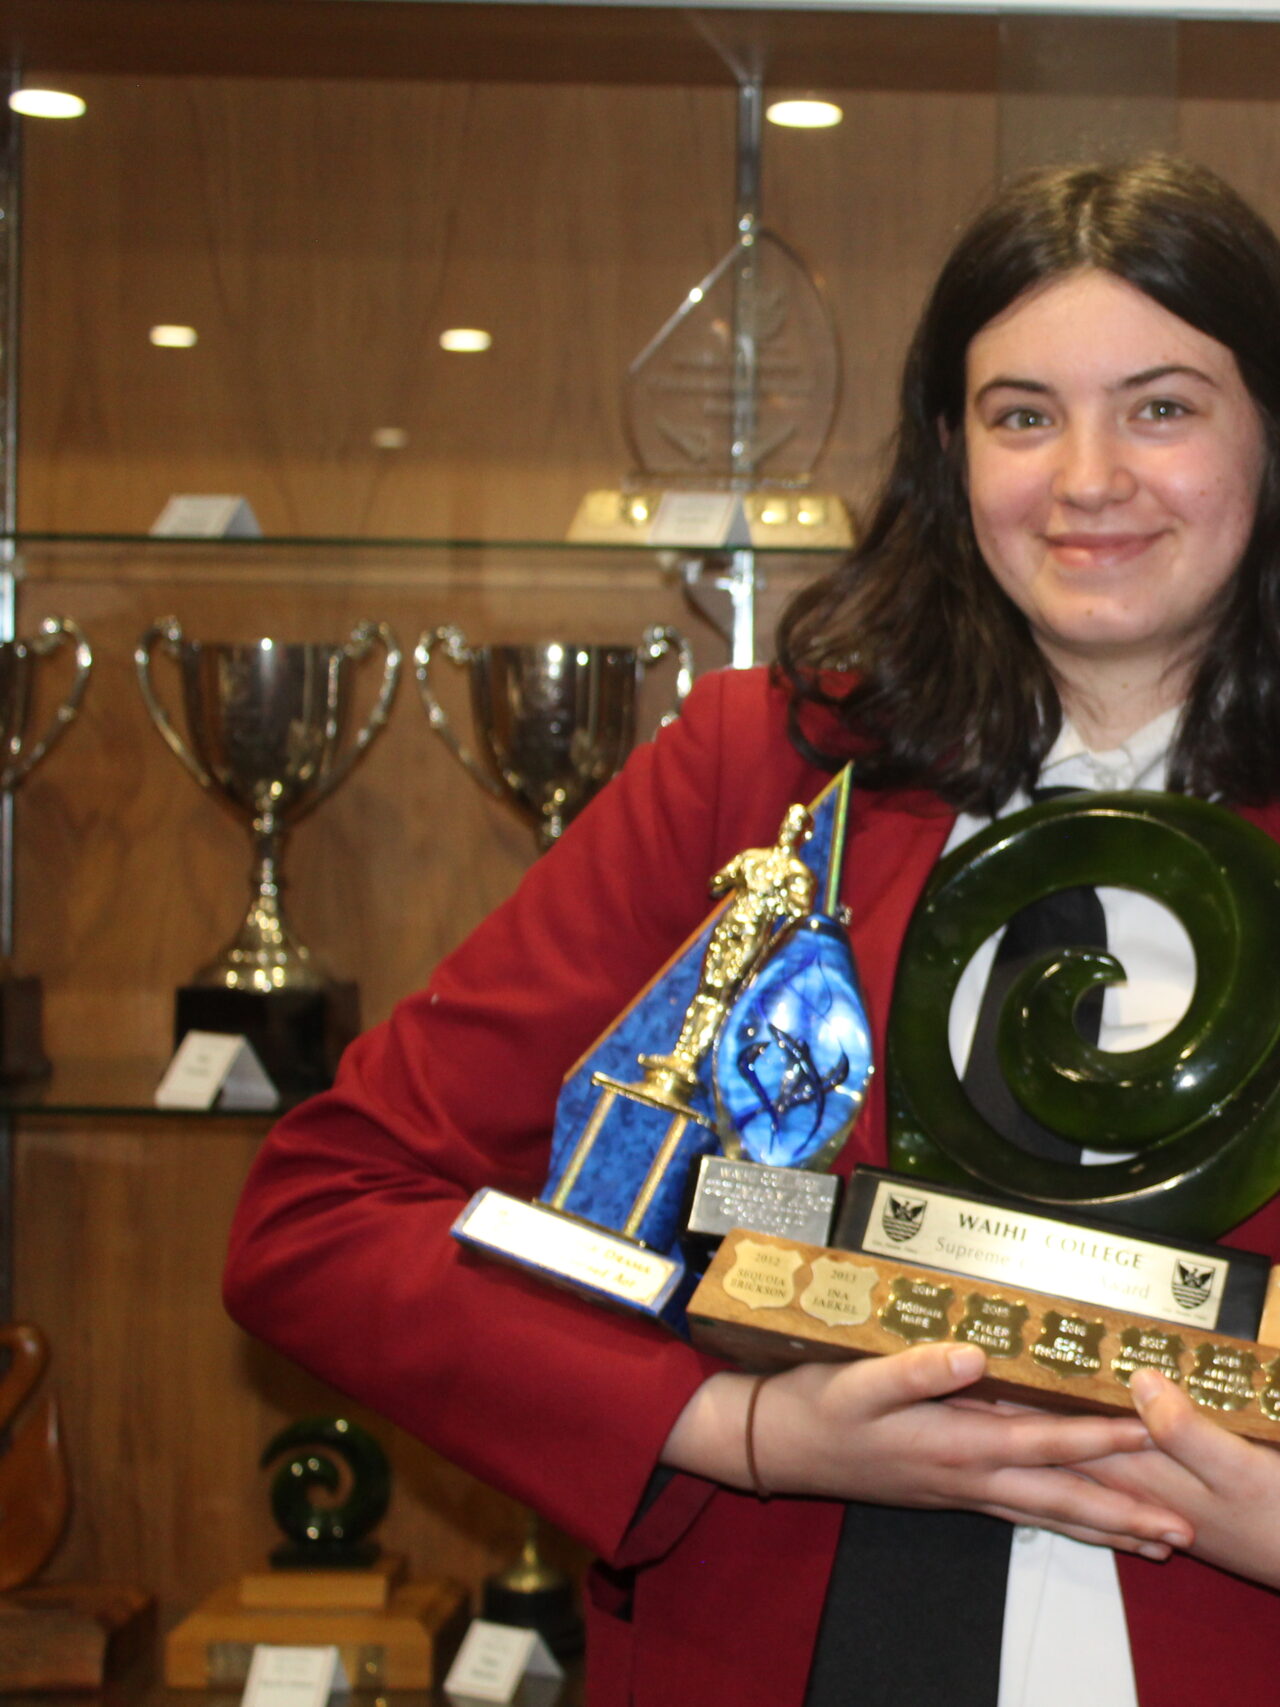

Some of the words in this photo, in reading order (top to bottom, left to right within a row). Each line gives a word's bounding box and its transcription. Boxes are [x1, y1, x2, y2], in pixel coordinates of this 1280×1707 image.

[958, 1212, 1028, 1242] WAIHI
[1045, 1234, 1145, 1269] COLLEGE
[755, 1253, 780, 1266] 2012
[935, 1237, 1011, 1266] Supreme
[737, 1268, 785, 1287] SEQUOIA
[730, 1277, 787, 1299] ERICKSON
[827, 1287, 849, 1300] INA
